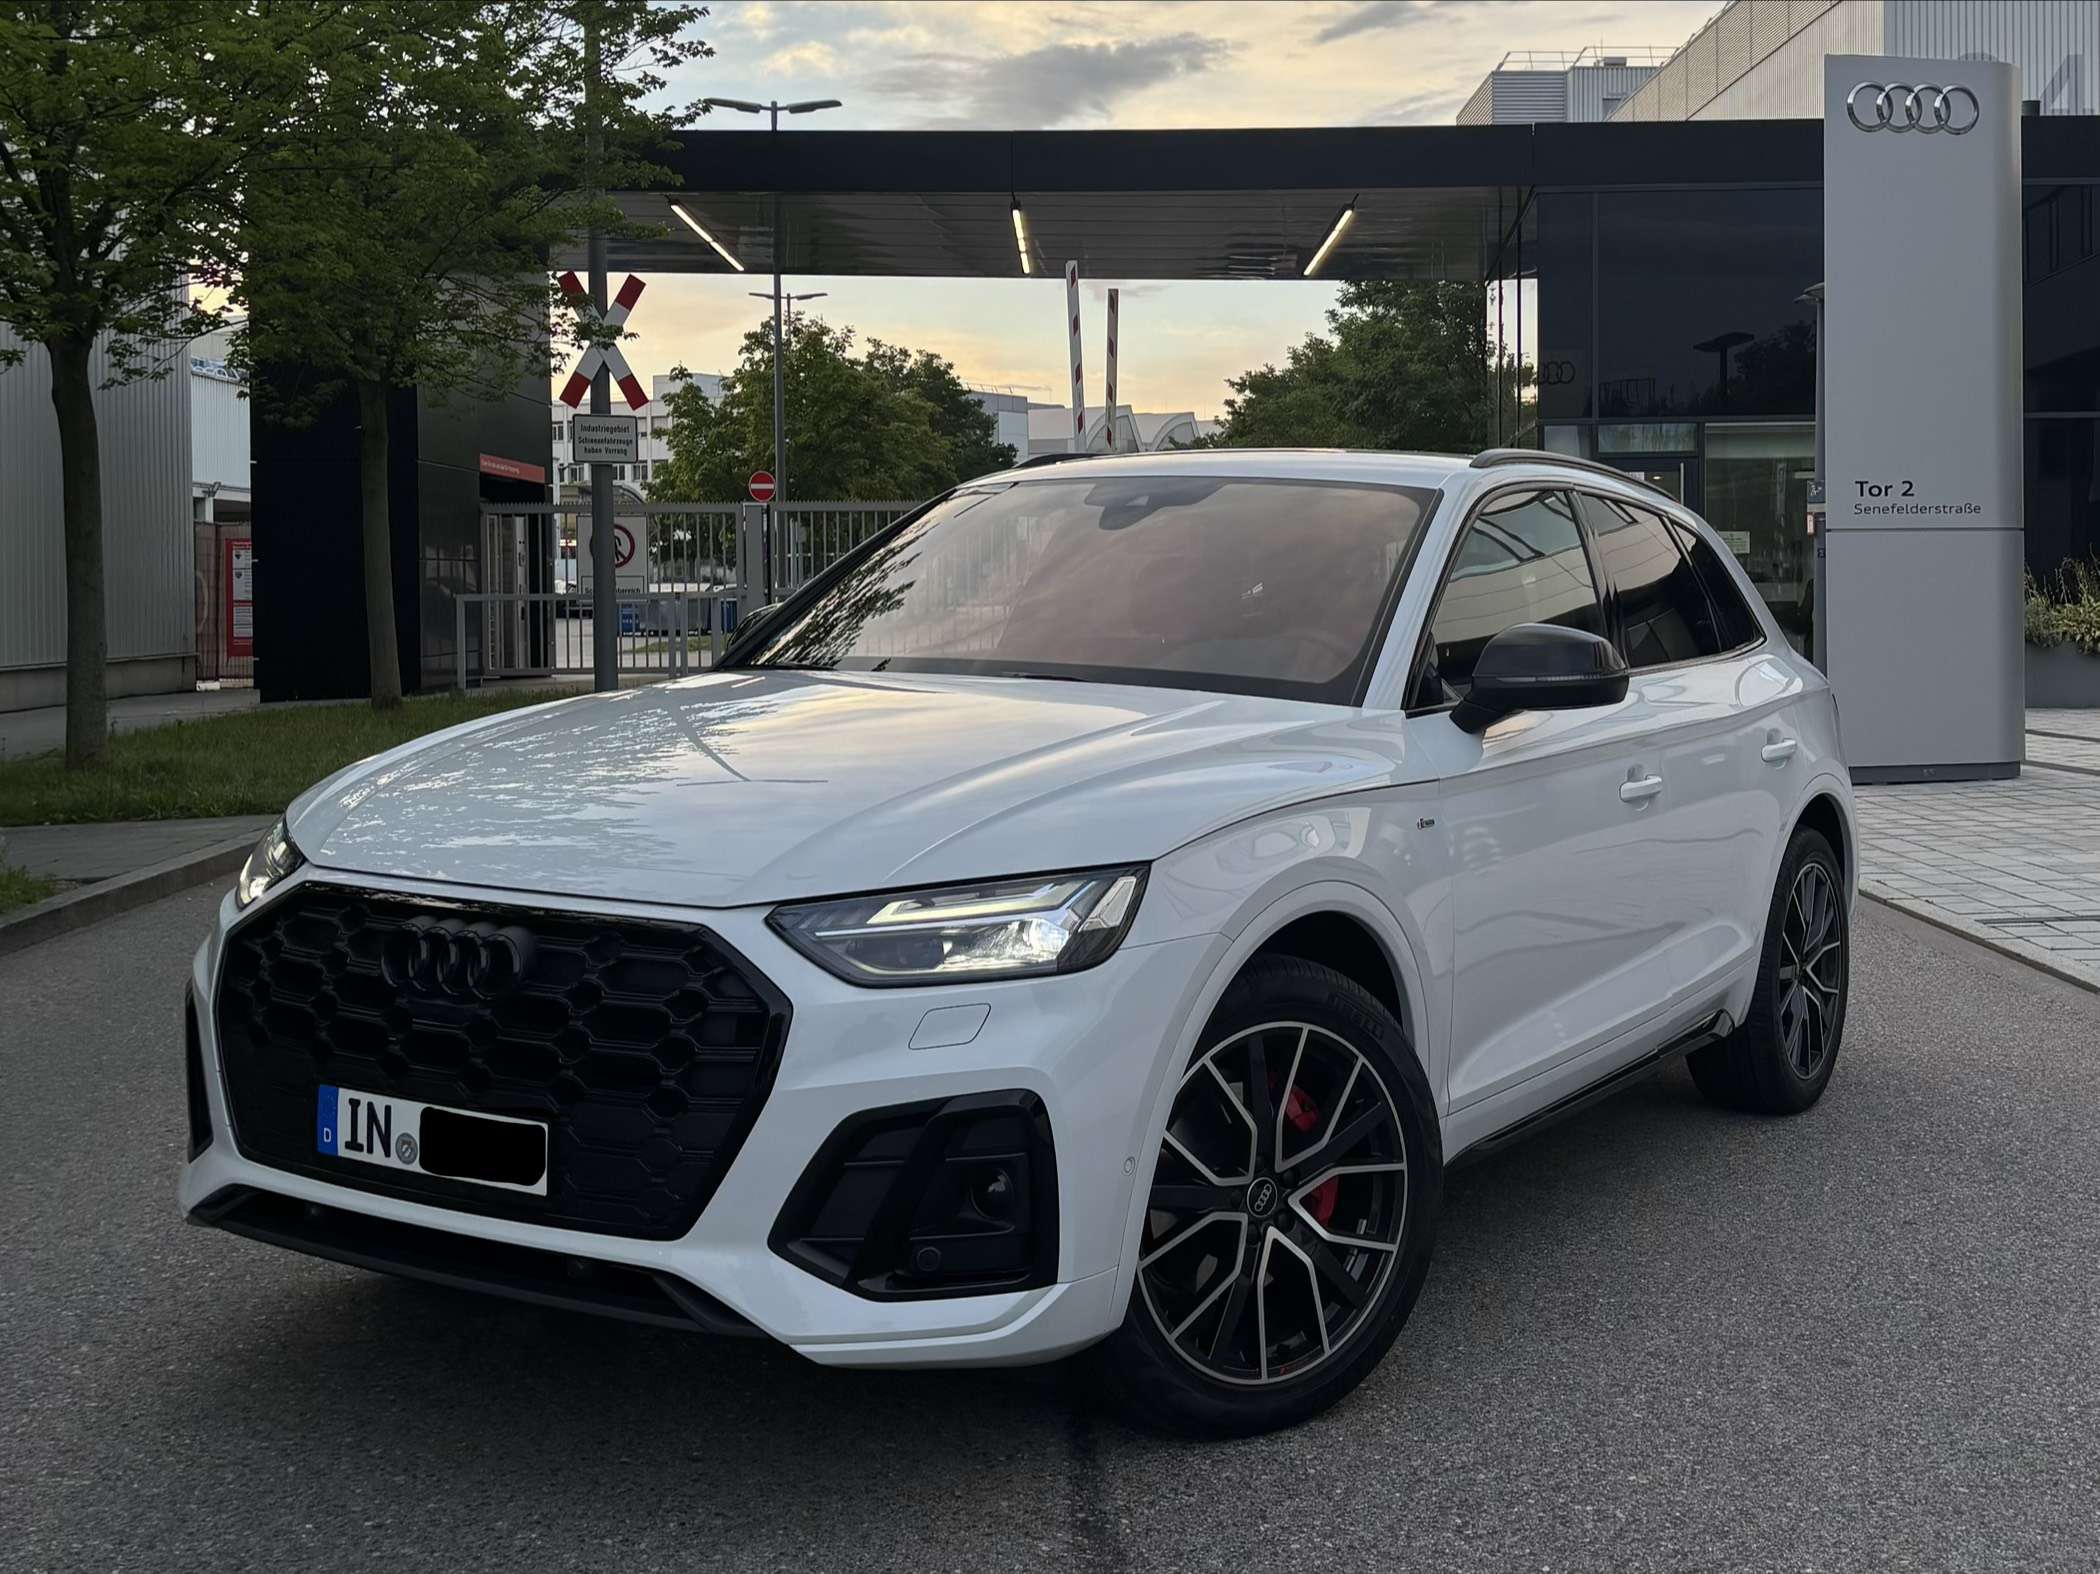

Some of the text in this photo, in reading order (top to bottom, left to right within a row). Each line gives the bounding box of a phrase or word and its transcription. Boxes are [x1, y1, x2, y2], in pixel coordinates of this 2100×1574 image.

[580, 423, 631, 435] Industriegebiet
[584, 445, 628, 457] haben Vorrang
[1854, 480, 1915, 497] Tor 2
[1853, 502, 1982, 515] Senefelderstraße
[345, 1097, 392, 1158] IN
[323, 1127, 332, 1143] D
